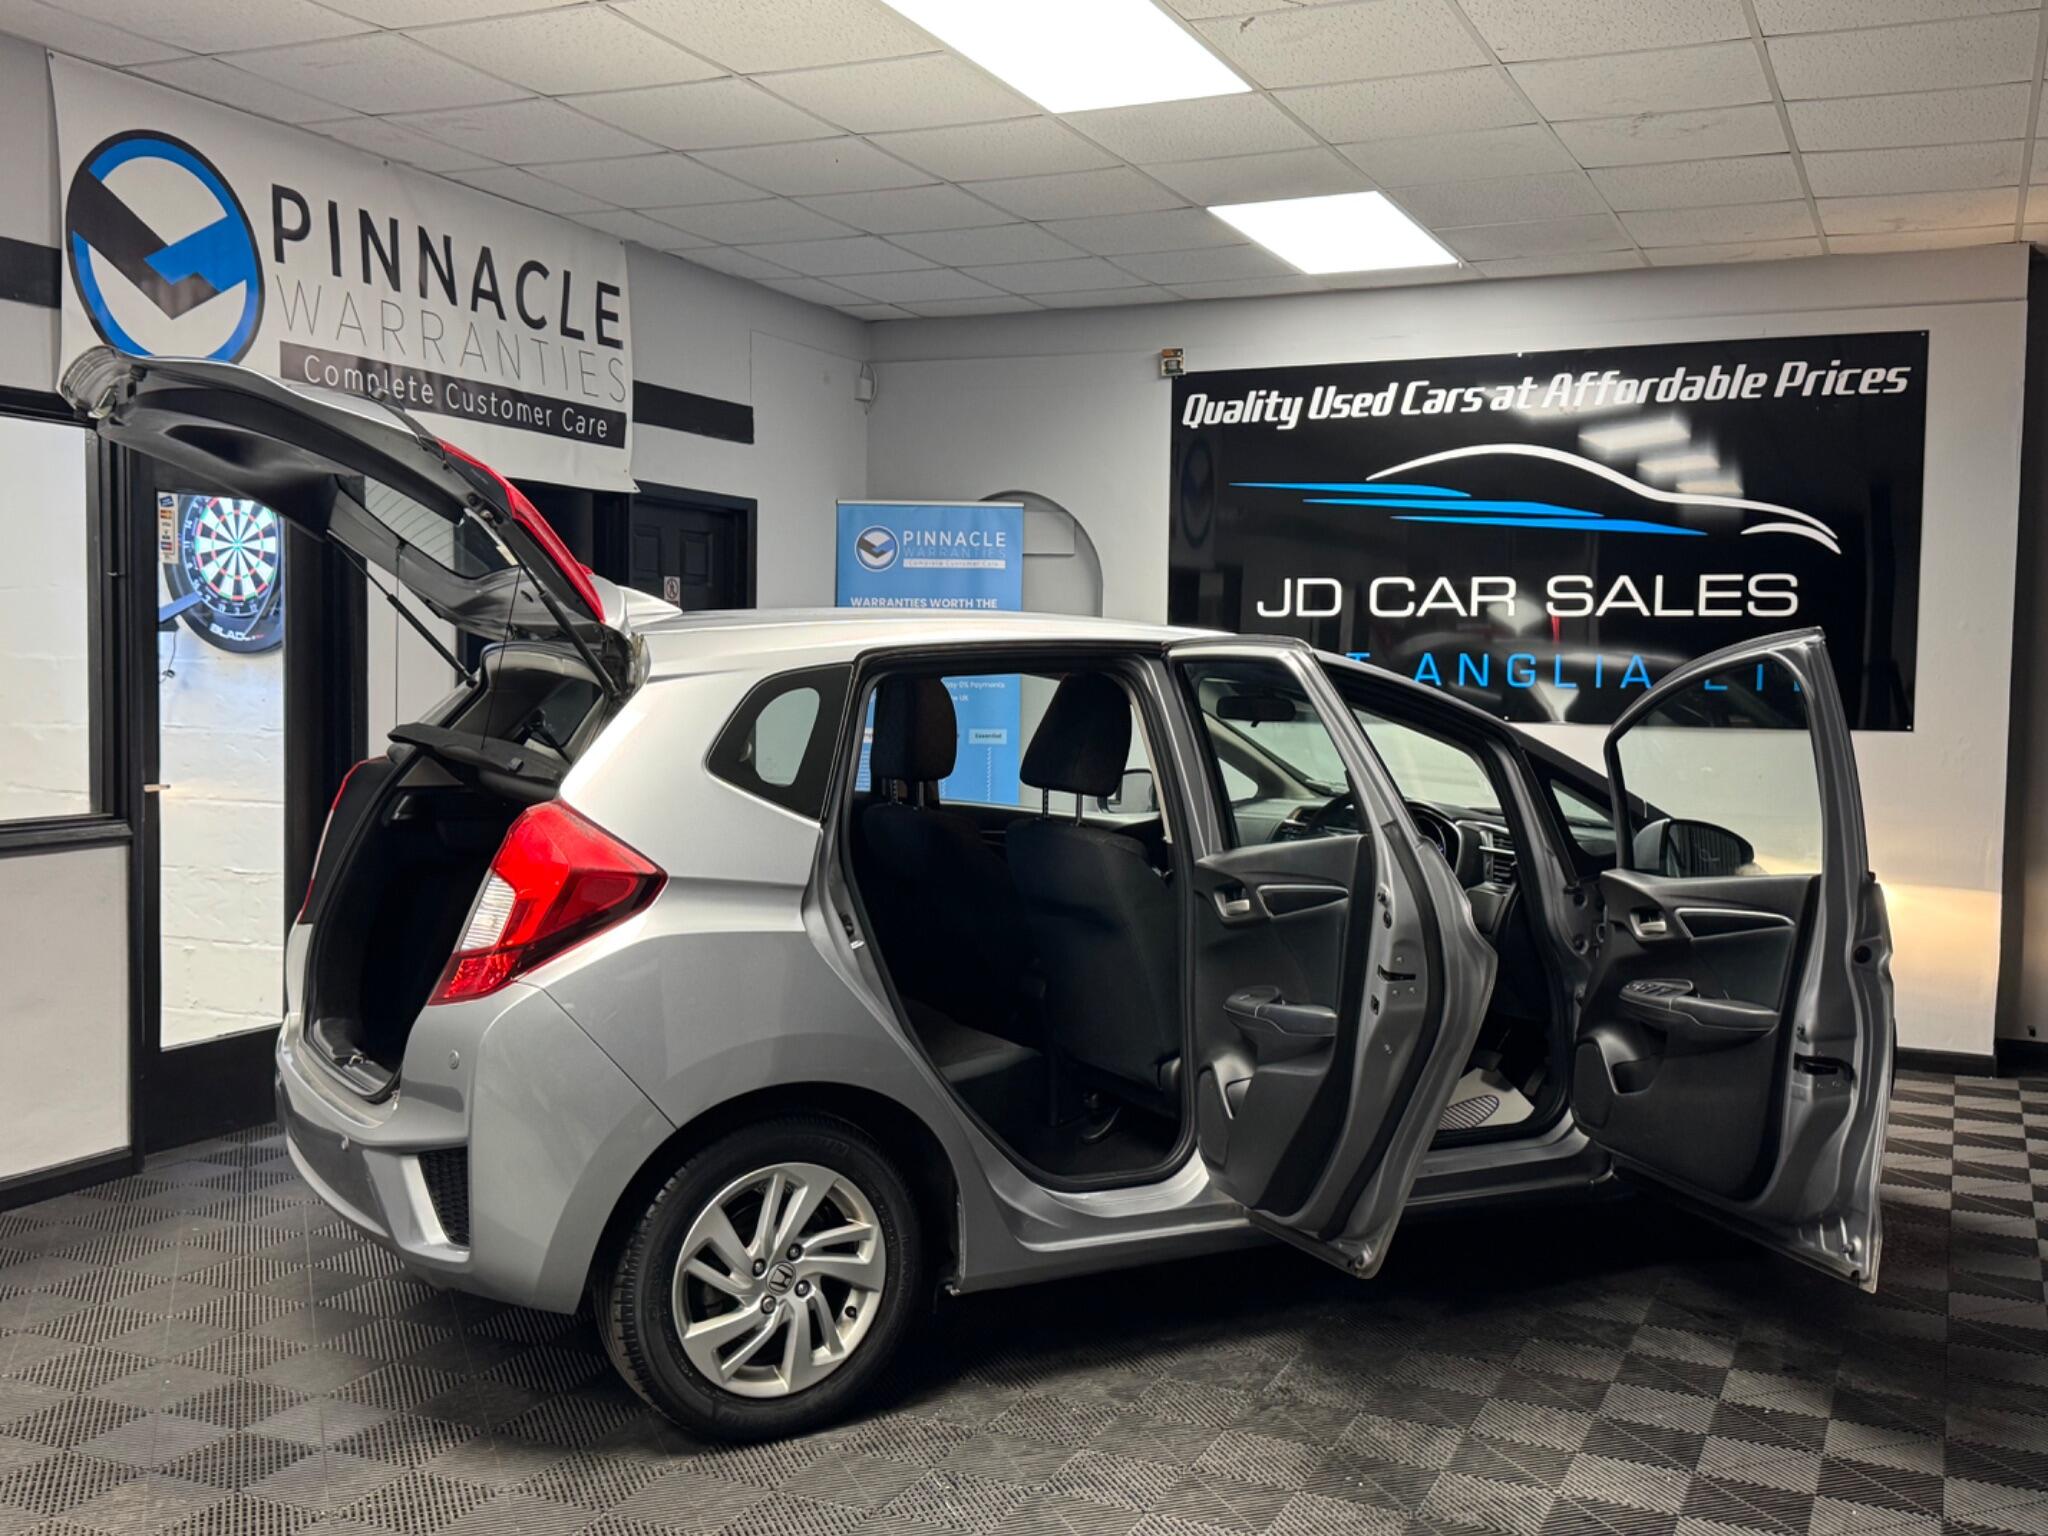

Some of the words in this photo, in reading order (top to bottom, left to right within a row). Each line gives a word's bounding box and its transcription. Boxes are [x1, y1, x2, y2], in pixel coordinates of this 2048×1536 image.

[272, 184, 624, 349] PINNACLE
[276, 274, 626, 403] WARRANTIES
[304, 355, 434, 404] Complete
[446, 383, 552, 427] Customer
[562, 407, 607, 438] Care
[1182, 390, 1303, 430] Quality
[1308, 382, 1399, 420] Used
[1400, 380, 1485, 415] Cars
[1490, 377, 1538, 411] at
[1541, 364, 1767, 408] Affordable
[1773, 360, 1911, 397] Prices
[903, 530, 1006, 547] PINNACLE
[904, 547, 1006, 558] WARRANTIES
[850, 597, 927, 608] WARRANTIES
[929, 598, 974, 608] WORTH
[975, 599, 998, 608] THE
[1257, 577, 1342, 618] JD
[1369, 576, 1516, 617] CAR
[1546, 574, 1798, 617] SALES
[970, 681, 1006, 690] Payments
[1413, 652, 1653, 689] ANGLIA
